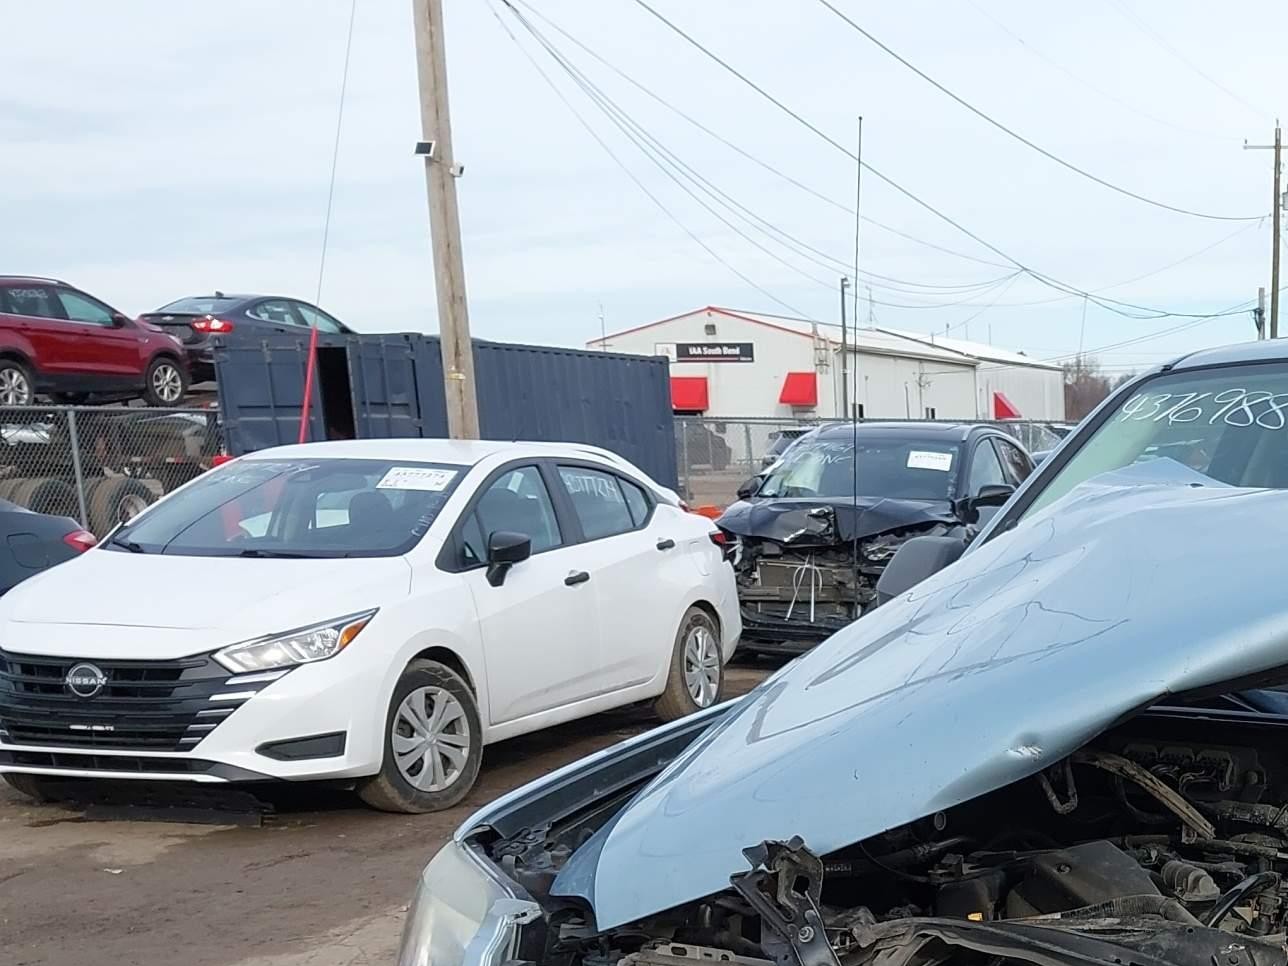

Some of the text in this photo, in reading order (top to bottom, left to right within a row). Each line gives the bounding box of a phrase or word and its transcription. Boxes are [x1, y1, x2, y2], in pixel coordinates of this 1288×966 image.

[703, 346, 722, 355] South
[723, 346, 740, 355] Bend
[65, 676, 107, 685] NISSAN
